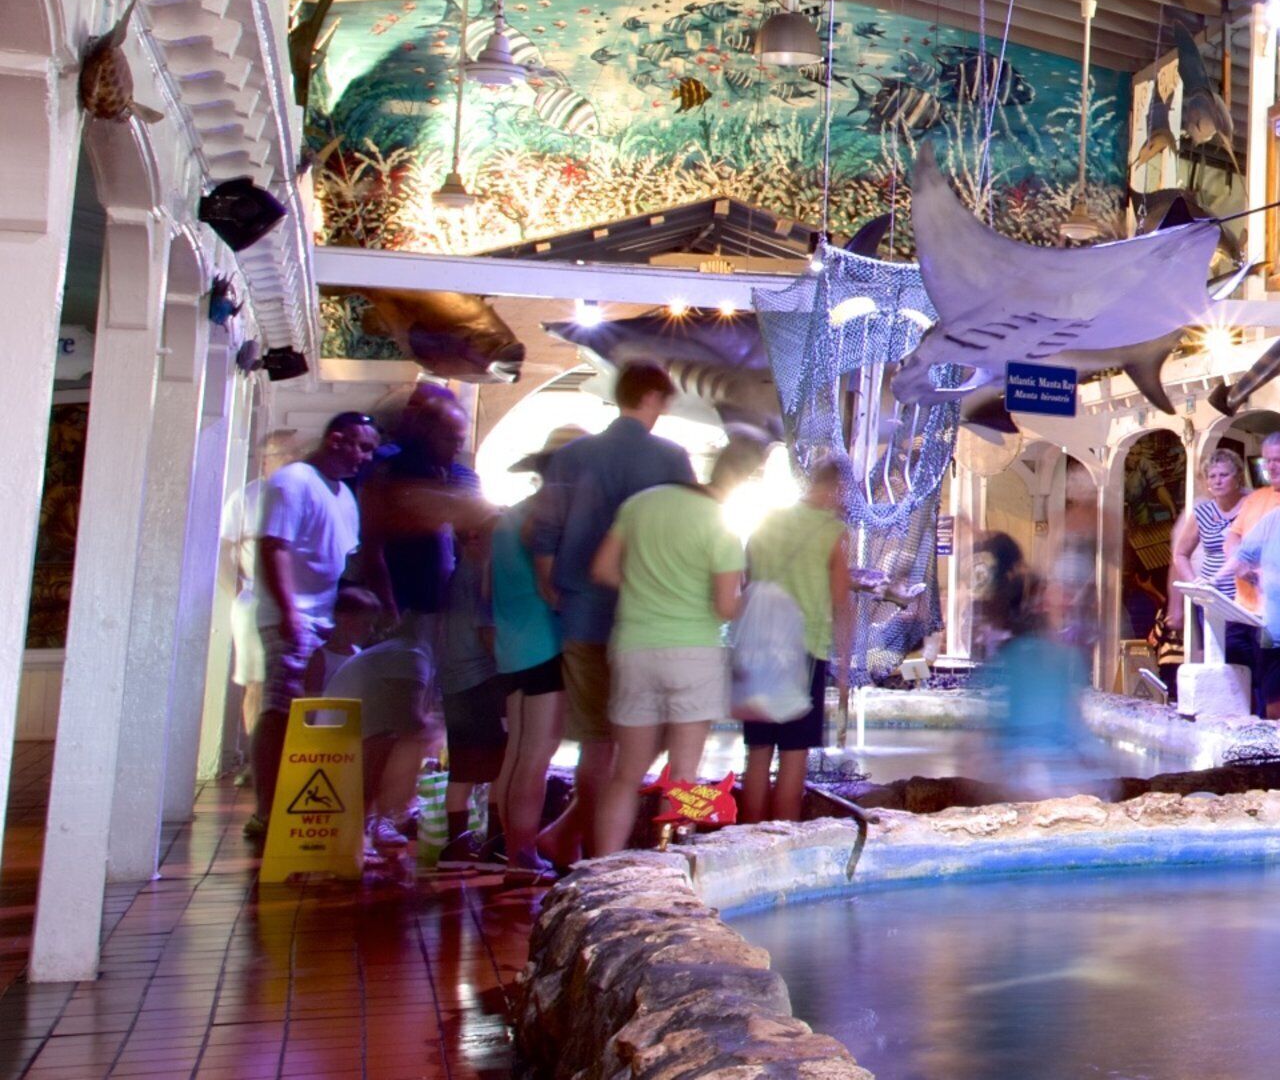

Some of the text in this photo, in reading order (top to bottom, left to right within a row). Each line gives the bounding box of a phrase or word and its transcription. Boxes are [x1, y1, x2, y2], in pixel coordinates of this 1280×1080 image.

[1008, 374, 1076, 393] Atlantic Manta Ray
[1013, 389, 1038, 400] Manta
[288, 752, 356, 764] CAUTION
[301, 814, 332, 825] WET
[289, 827, 339, 838] FLOOR
